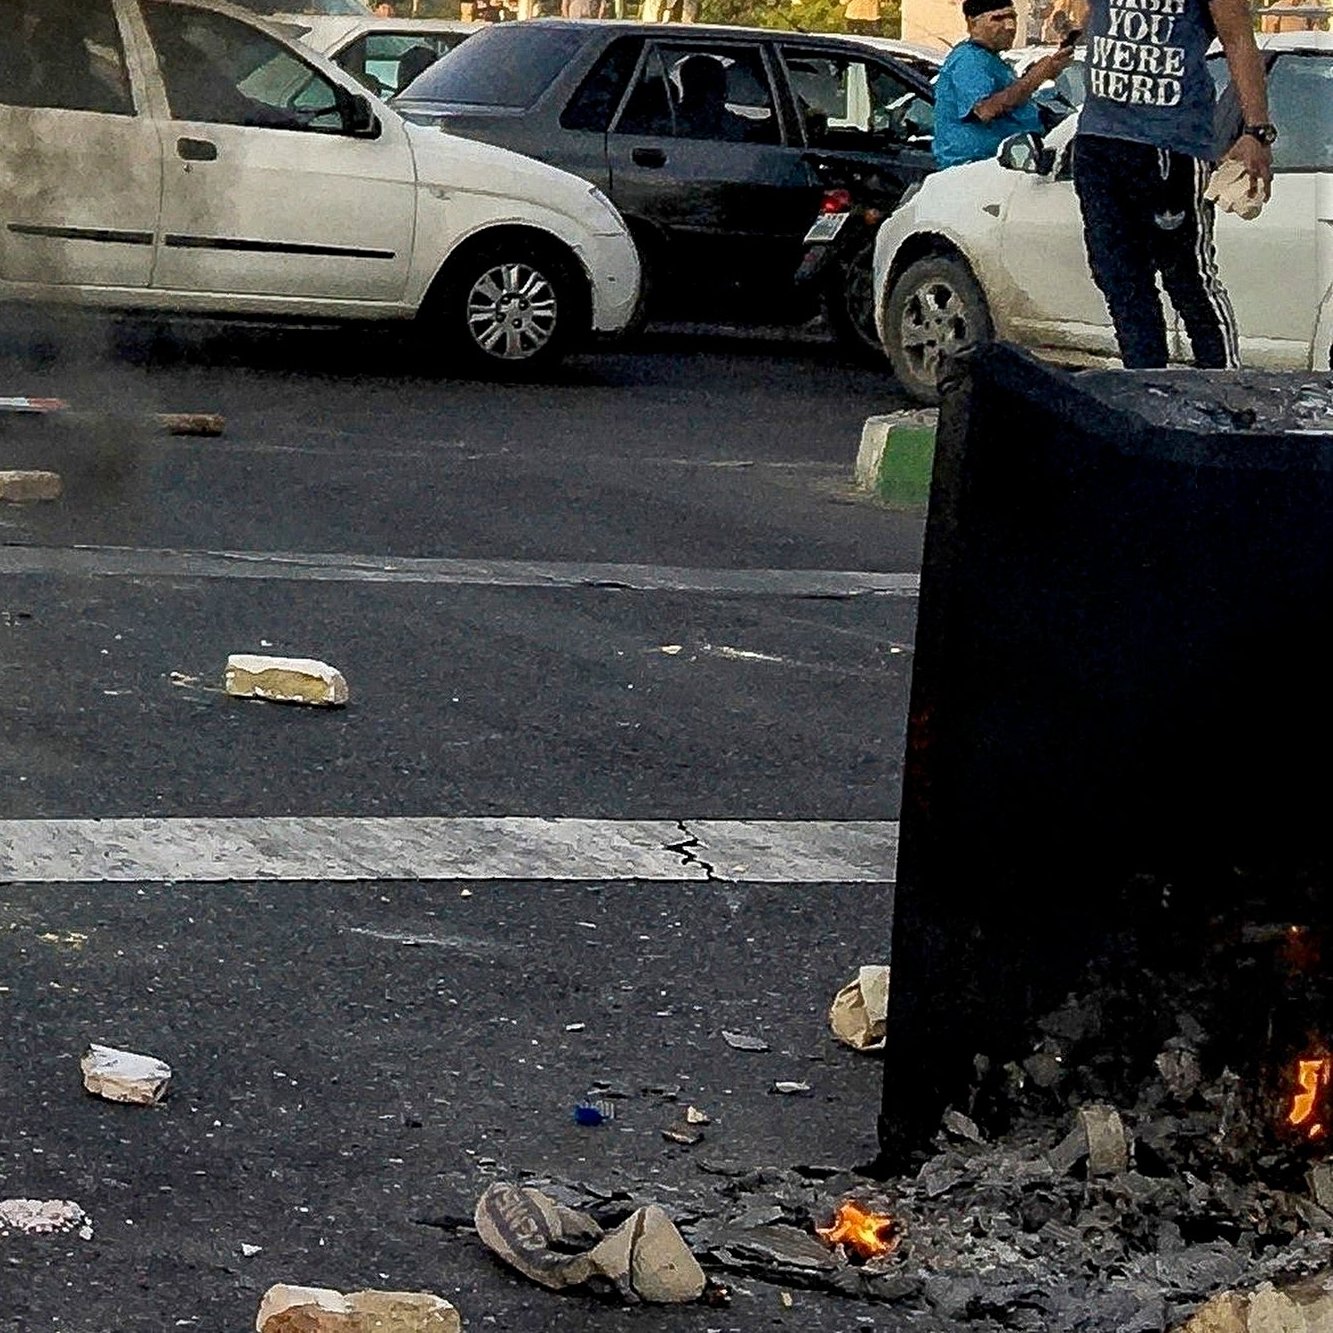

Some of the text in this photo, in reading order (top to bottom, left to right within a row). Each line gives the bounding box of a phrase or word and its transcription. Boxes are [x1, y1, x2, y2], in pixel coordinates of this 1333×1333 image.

[1107, 8, 1175, 45] YOU
[1093, 35, 1185, 77] WERE
[1091, 67, 1182, 106] HERD
